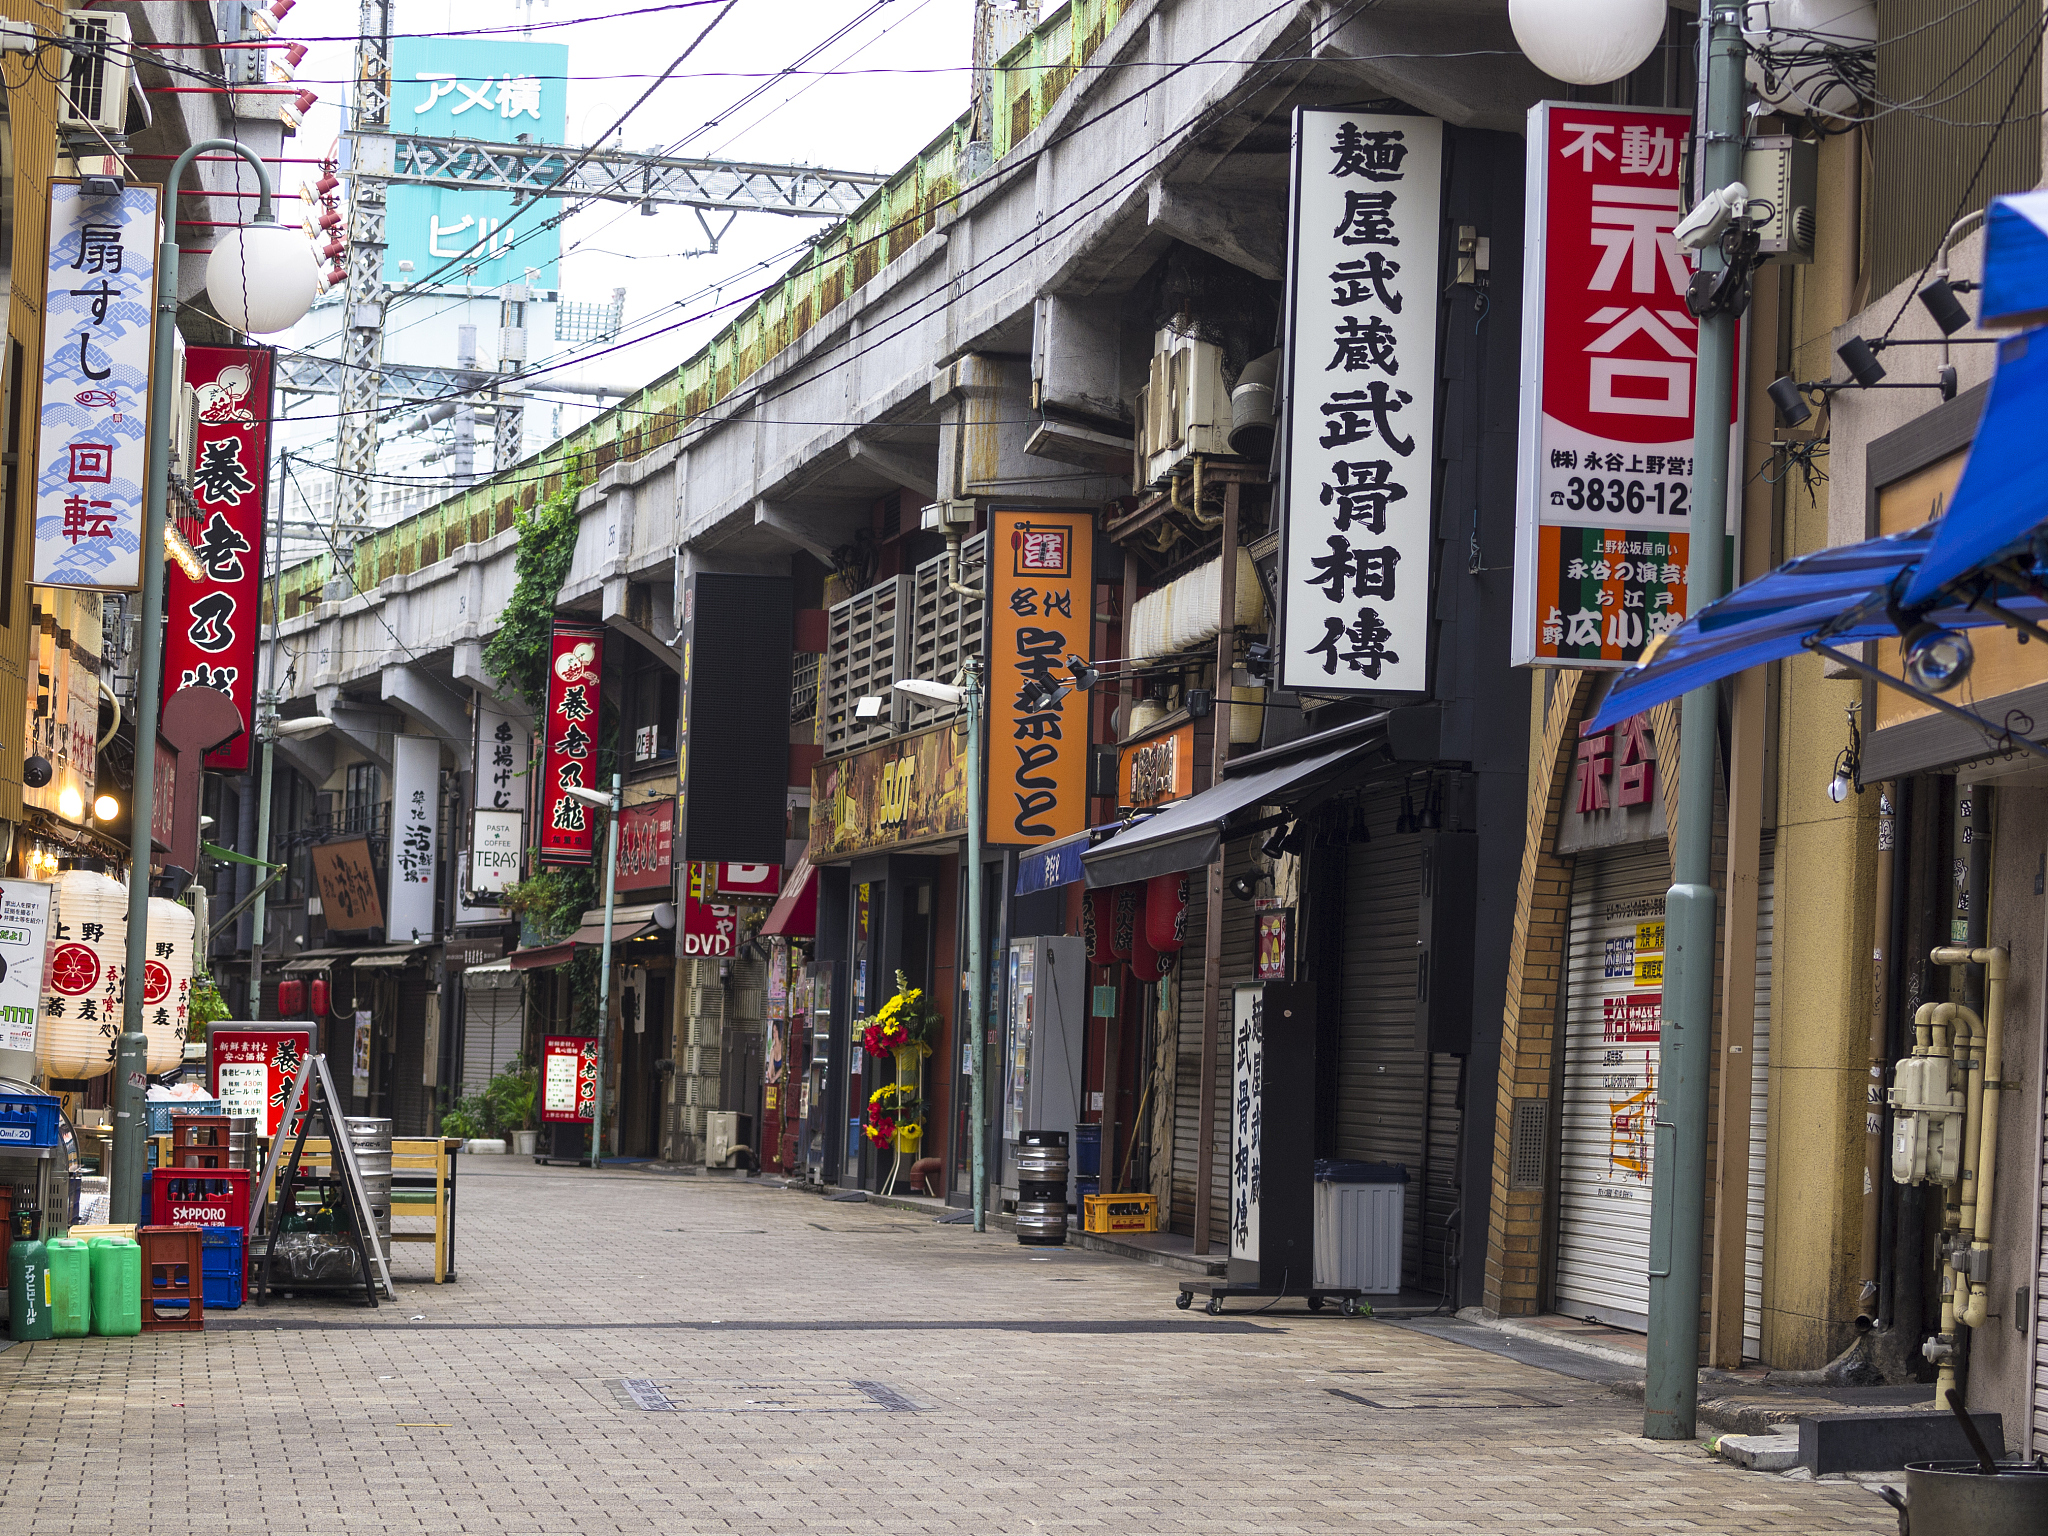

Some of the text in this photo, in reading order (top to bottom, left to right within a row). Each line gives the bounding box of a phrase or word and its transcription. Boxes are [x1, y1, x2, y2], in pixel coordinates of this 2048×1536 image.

[414, 72, 542, 120] アメ横
[1560, 121, 1684, 178] 不動
[430, 214, 515, 260] ビル
[71, 223, 124, 381] 扇すし
[1584, 452, 1694, 476] 永谷上野営
[62, 443, 118, 545] 回転
[1567, 477, 1692, 516] 3836-12
[1593, 540, 1678, 557] 上野松坂屋向い
[1567, 558, 1689, 585] 永谷の演芸
[1595, 589, 1674, 609] お江戸
[1542, 606, 1564, 647] 上野
[678, 638, 691, 837] SLOT
[551, 684, 594, 831] 養老乃瀧
[880, 754, 916, 829] SLOT
[487, 824, 510, 832] PASTA
[484, 839, 511, 848] COFFEE
[475, 850, 519, 868] TERAS
[56, 922, 105, 943] 上野
[685, 933, 730, 956] DVD
[155, 942, 175, 960] 野
[153, 1008, 171, 1026] 麦
[219, 1041, 269, 1052] 新鮮素材と
[224, 1052, 266, 1062] 安心価格
